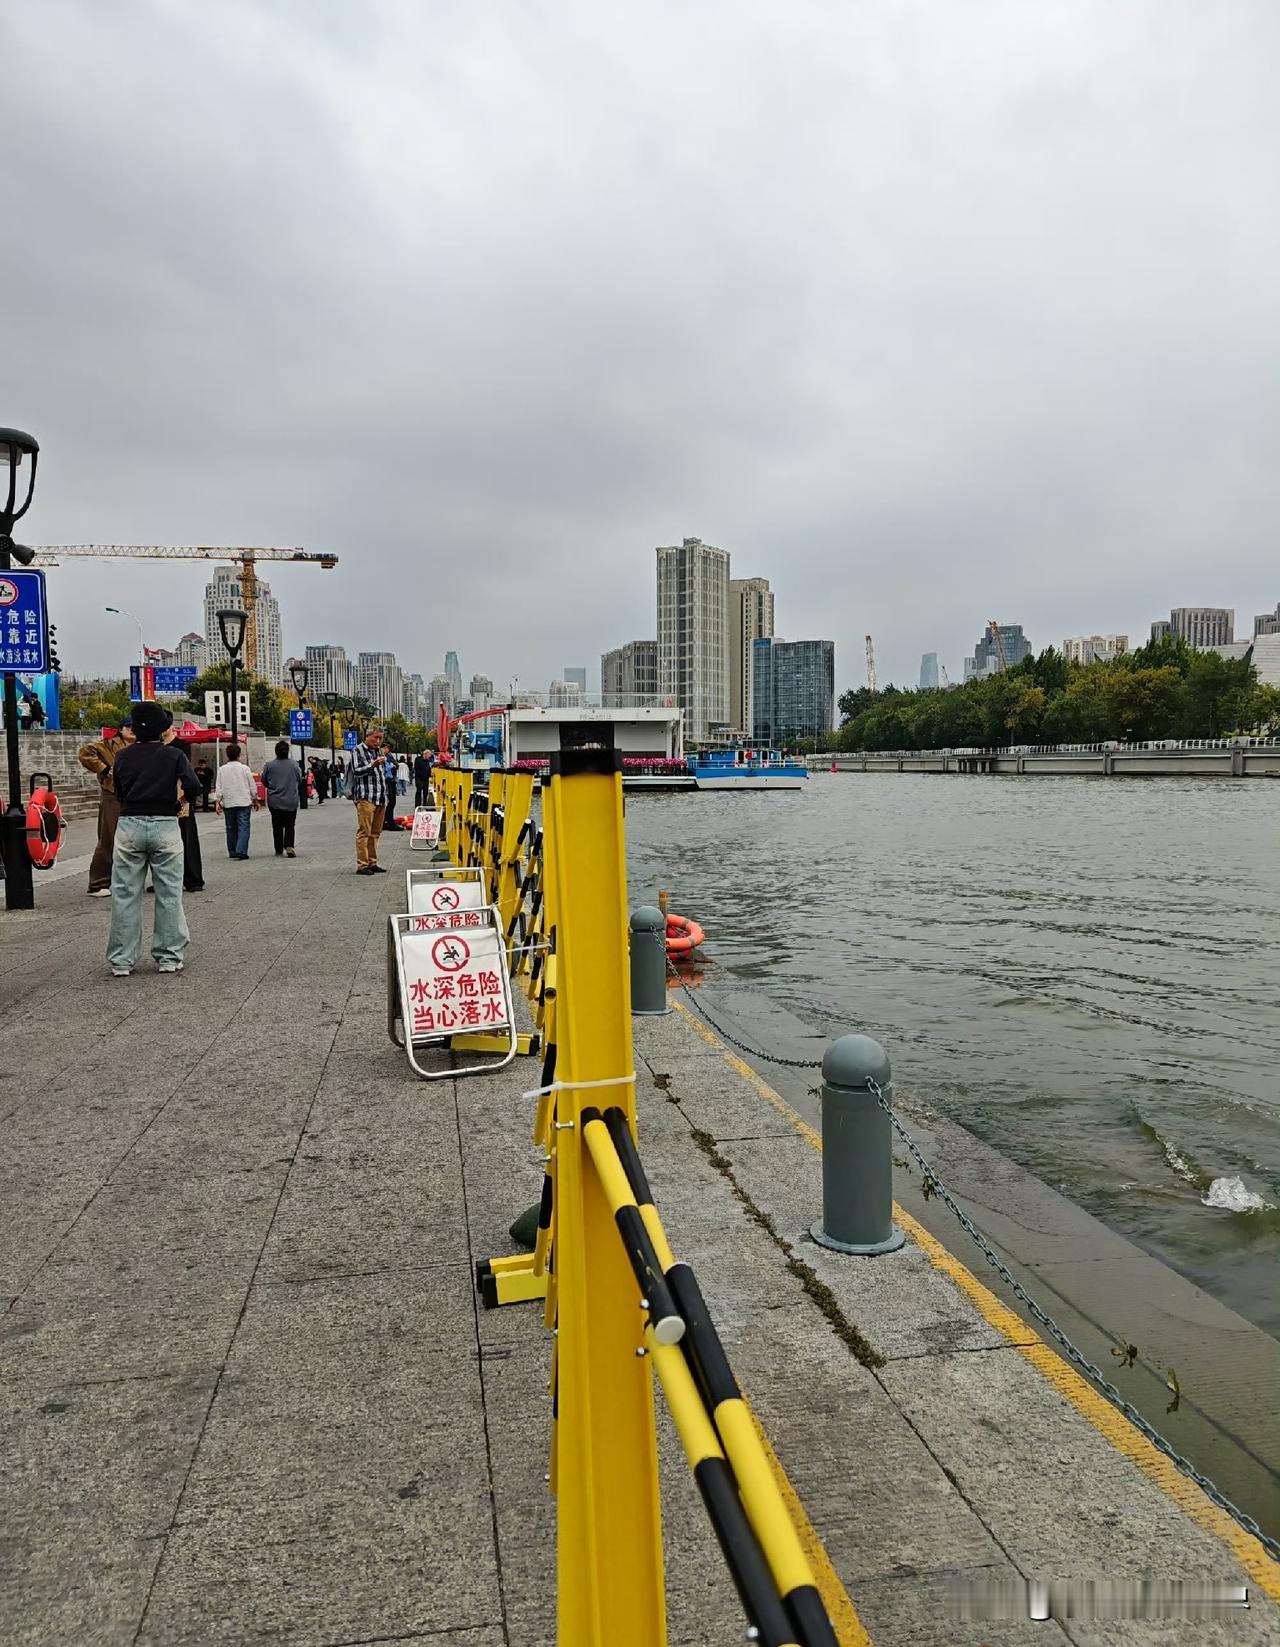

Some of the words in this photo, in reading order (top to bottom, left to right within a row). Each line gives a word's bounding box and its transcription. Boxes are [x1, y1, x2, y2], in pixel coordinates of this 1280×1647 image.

[0, 609, 37, 625] 危险
[0, 628, 38, 645] 靠近
[415, 913, 480, 930] 水深危险
[409, 971, 501, 1003] 水深危险
[414, 998, 504, 1030] 当心落水
